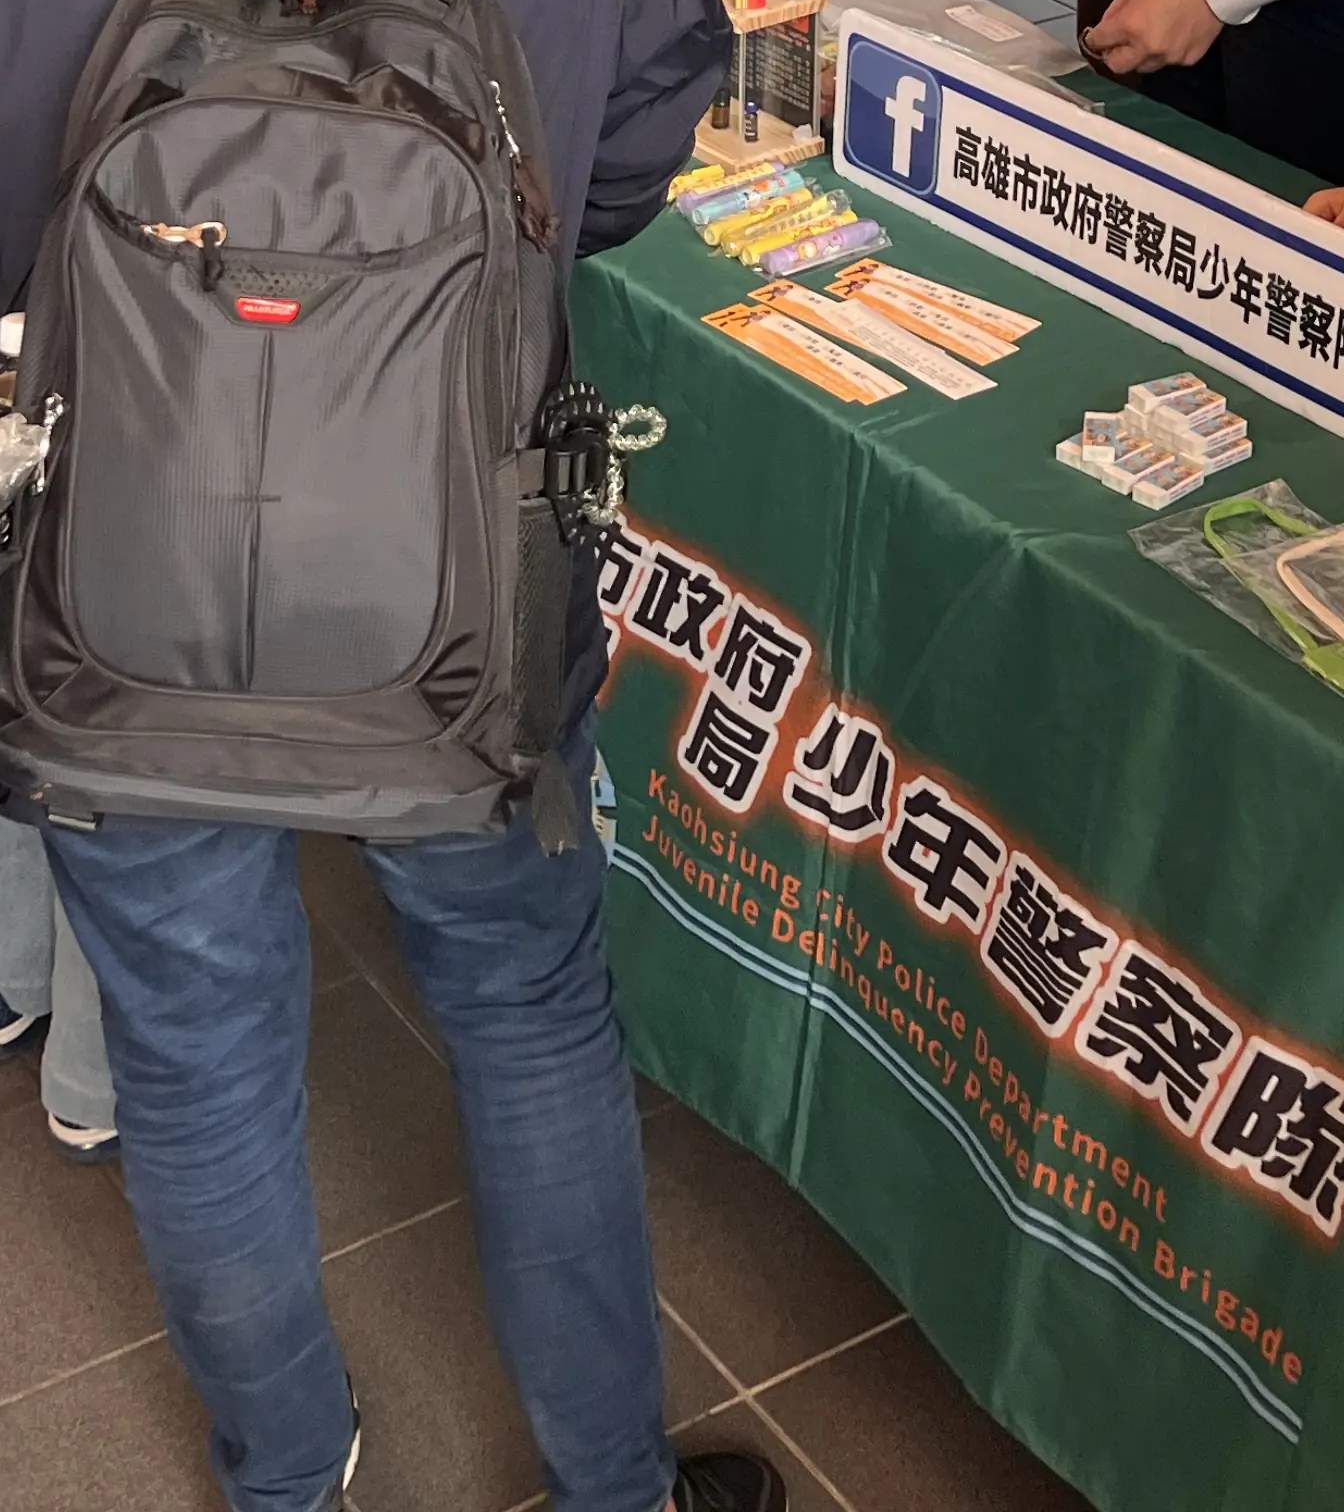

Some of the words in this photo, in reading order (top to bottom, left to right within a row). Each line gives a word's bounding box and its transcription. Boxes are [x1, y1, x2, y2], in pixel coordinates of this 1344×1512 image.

[596, 518, 805, 716] 市政府
[641, 815, 760, 926] Juvenile
[771, 908, 958, 1090] Delinquency
[963, 1070, 1141, 1253] Prevention
[1154, 1240, 1303, 1385] Brigade
[647, 768, 803, 909] Kaohsiung
[817, 888, 870, 958] City
[876, 940, 967, 1042] Police
[974, 1025, 1169, 1223] Department
